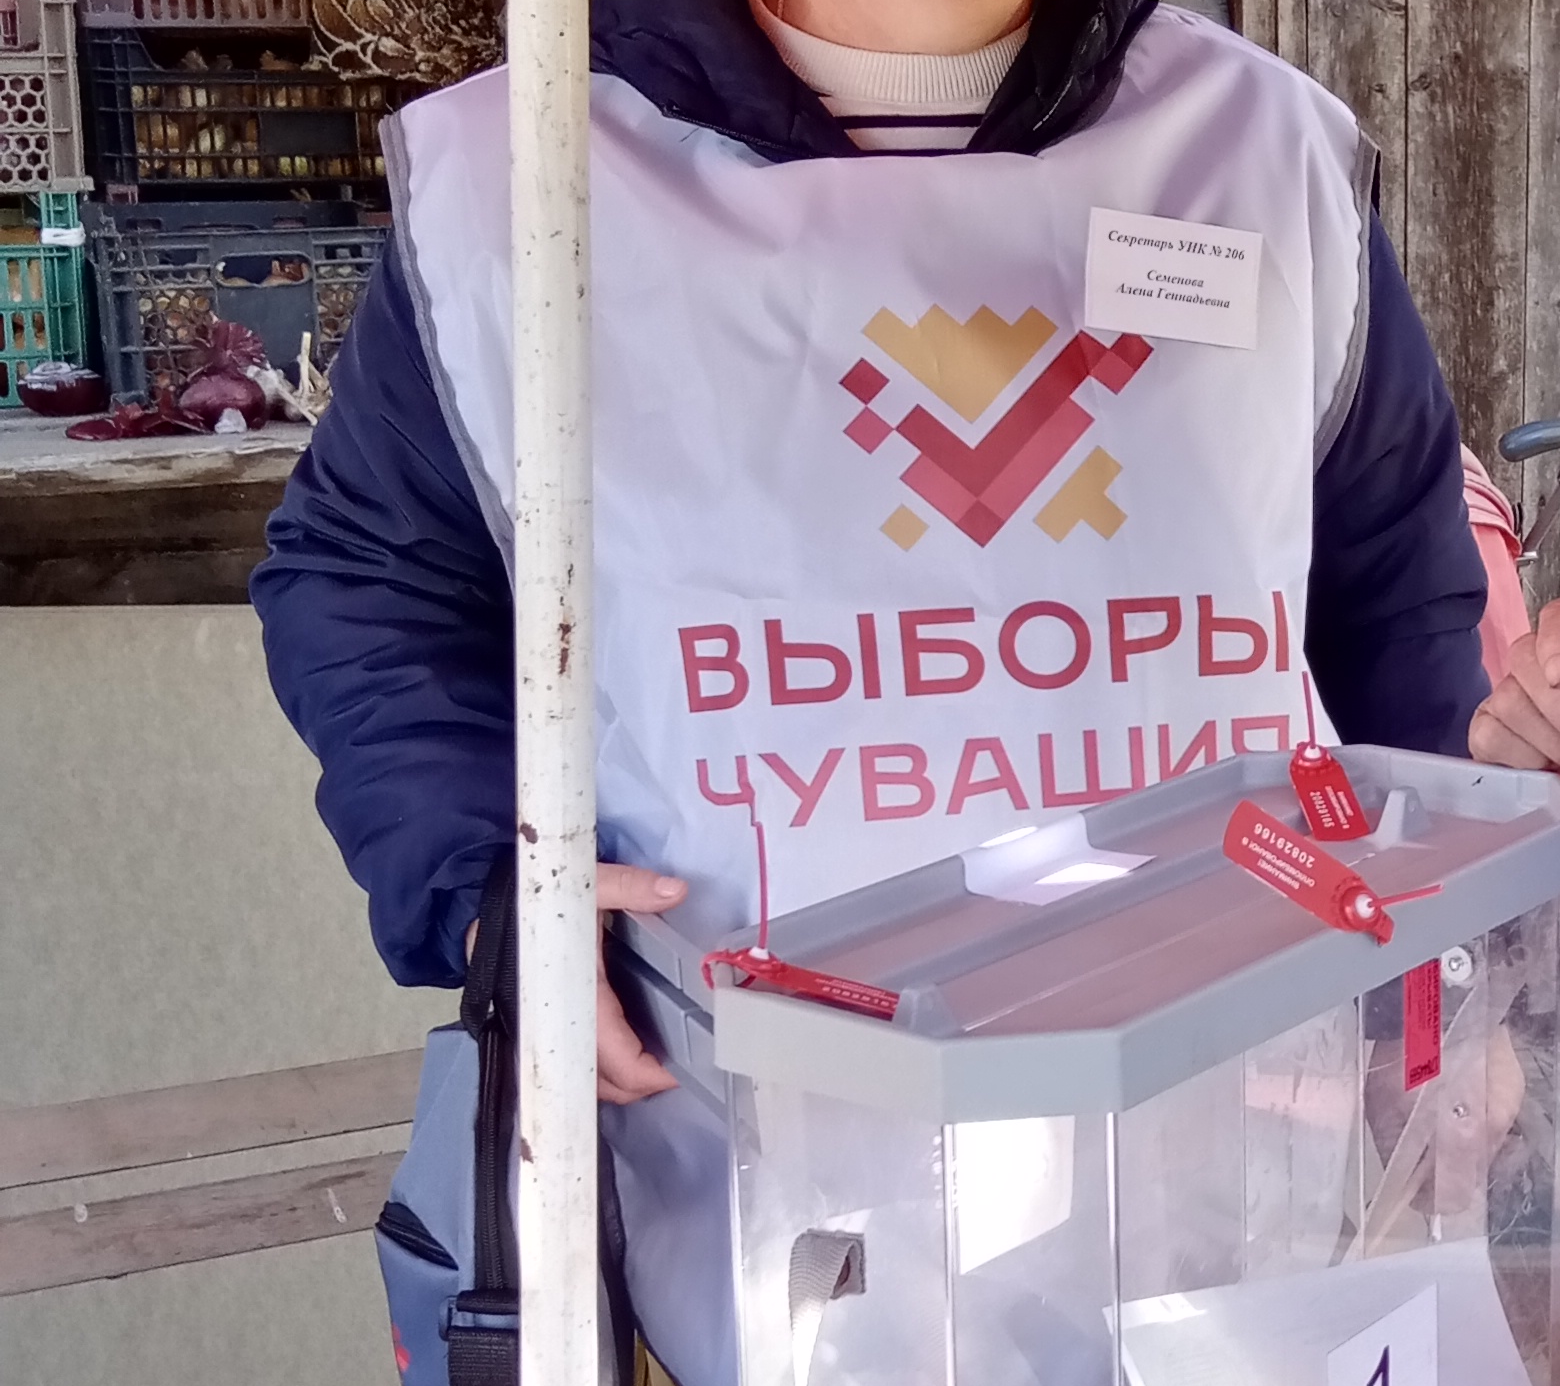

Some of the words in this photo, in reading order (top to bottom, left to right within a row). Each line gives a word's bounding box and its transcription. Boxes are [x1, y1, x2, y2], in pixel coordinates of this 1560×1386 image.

[1108, 230, 1174, 252] Секретарь
[1209, 245, 1222, 257] №
[1225, 247, 1246, 261] 206
[1147, 269, 1205, 288] Семенова
[1116, 282, 1154, 298] Алена
[1156, 288, 1231, 309] Геннадьевна
[678, 590, 1291, 713] ВЫБОРЫ
[1253, 823, 1316, 868] 20829166
